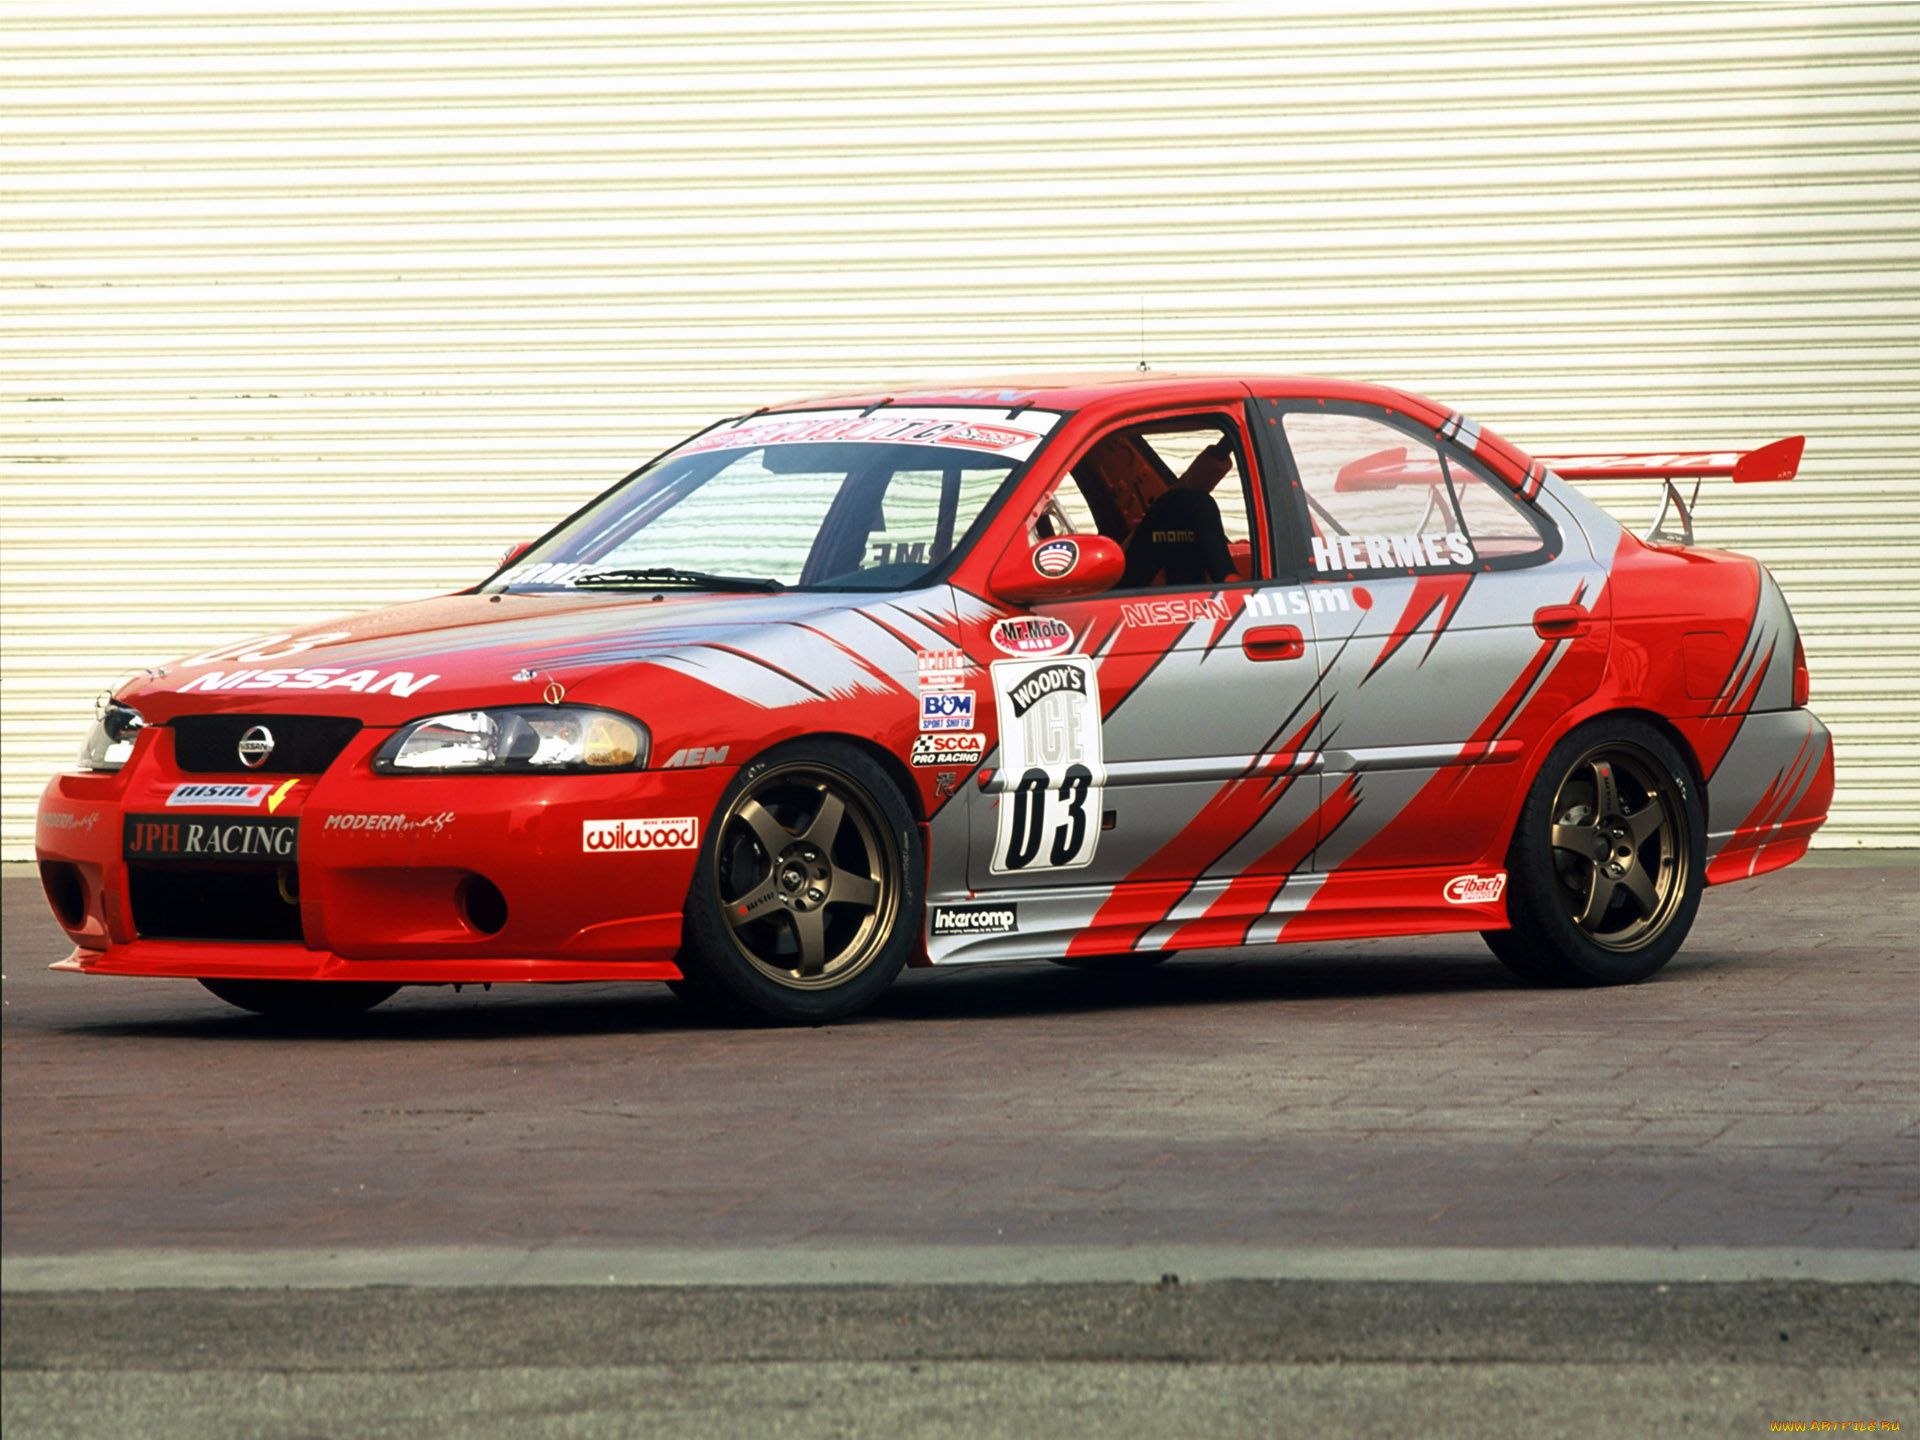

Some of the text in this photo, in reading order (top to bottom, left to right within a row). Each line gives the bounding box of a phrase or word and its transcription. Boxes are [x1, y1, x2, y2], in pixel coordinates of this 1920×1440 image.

[1311, 533, 1473, 573] HERMES
[1120, 599, 1231, 628] NISSAN
[1018, 639, 1053, 650] WASH
[919, 656, 964, 670] SPEED
[176, 668, 440, 697] NISSAN
[1013, 666, 1082, 709] WOODY'S
[924, 694, 971, 716] B&M
[923, 719, 943, 729] SPORT
[1024, 693, 1084, 767] ICE
[240, 742, 268, 751] NISSAN
[934, 737, 981, 751] SCCA
[662, 745, 730, 768] AEM
[912, 752, 979, 764] PRO RACING
[1005, 763, 1092, 870] 03
[129, 823, 294, 855] JPH RACING
[586, 819, 696, 850] wilwood
[1446, 877, 1502, 900] Eibach
[935, 908, 1015, 931] Intercomp
